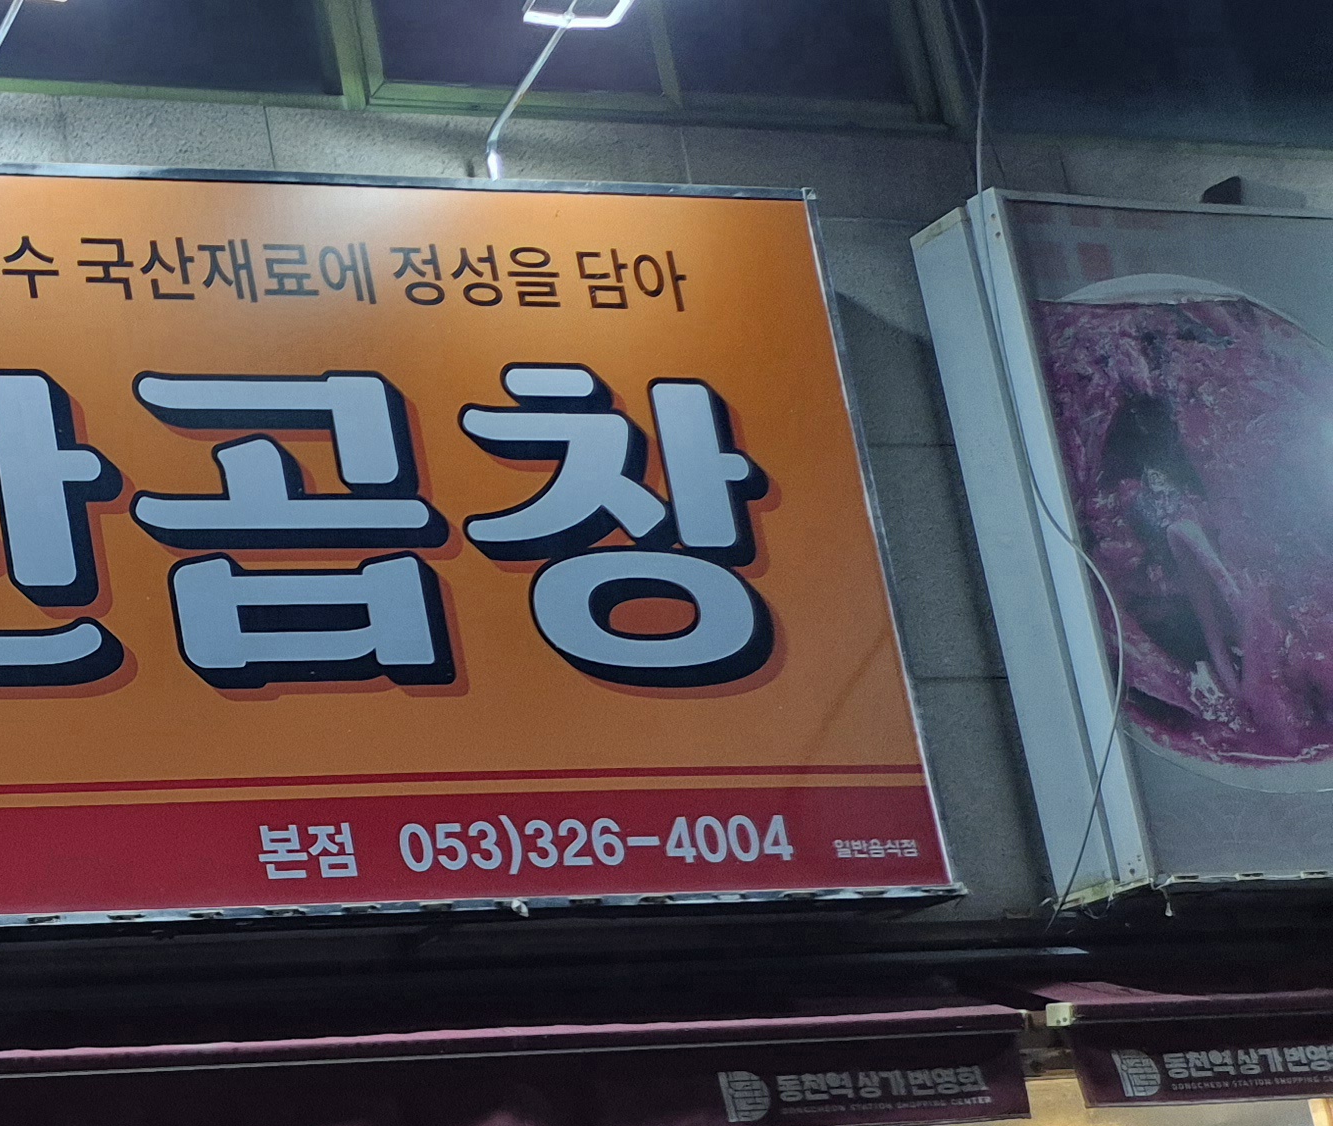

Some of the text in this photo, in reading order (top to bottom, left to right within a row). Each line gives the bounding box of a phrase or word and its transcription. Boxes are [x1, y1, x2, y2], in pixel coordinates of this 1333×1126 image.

[76, 237, 378, 304] 국산재료에
[391, 245, 563, 308] 정성을
[576, 248, 688, 312] 담아
[258, 814, 794, 881] 본점 053)326-4004
[833, 837, 919, 860] 일반음식점
[1162, 1050, 1235, 1078] 동천역
[1237, 1048, 1283, 1075] 상가
[776, 1065, 990, 1102] 동천역 상가 번영회
